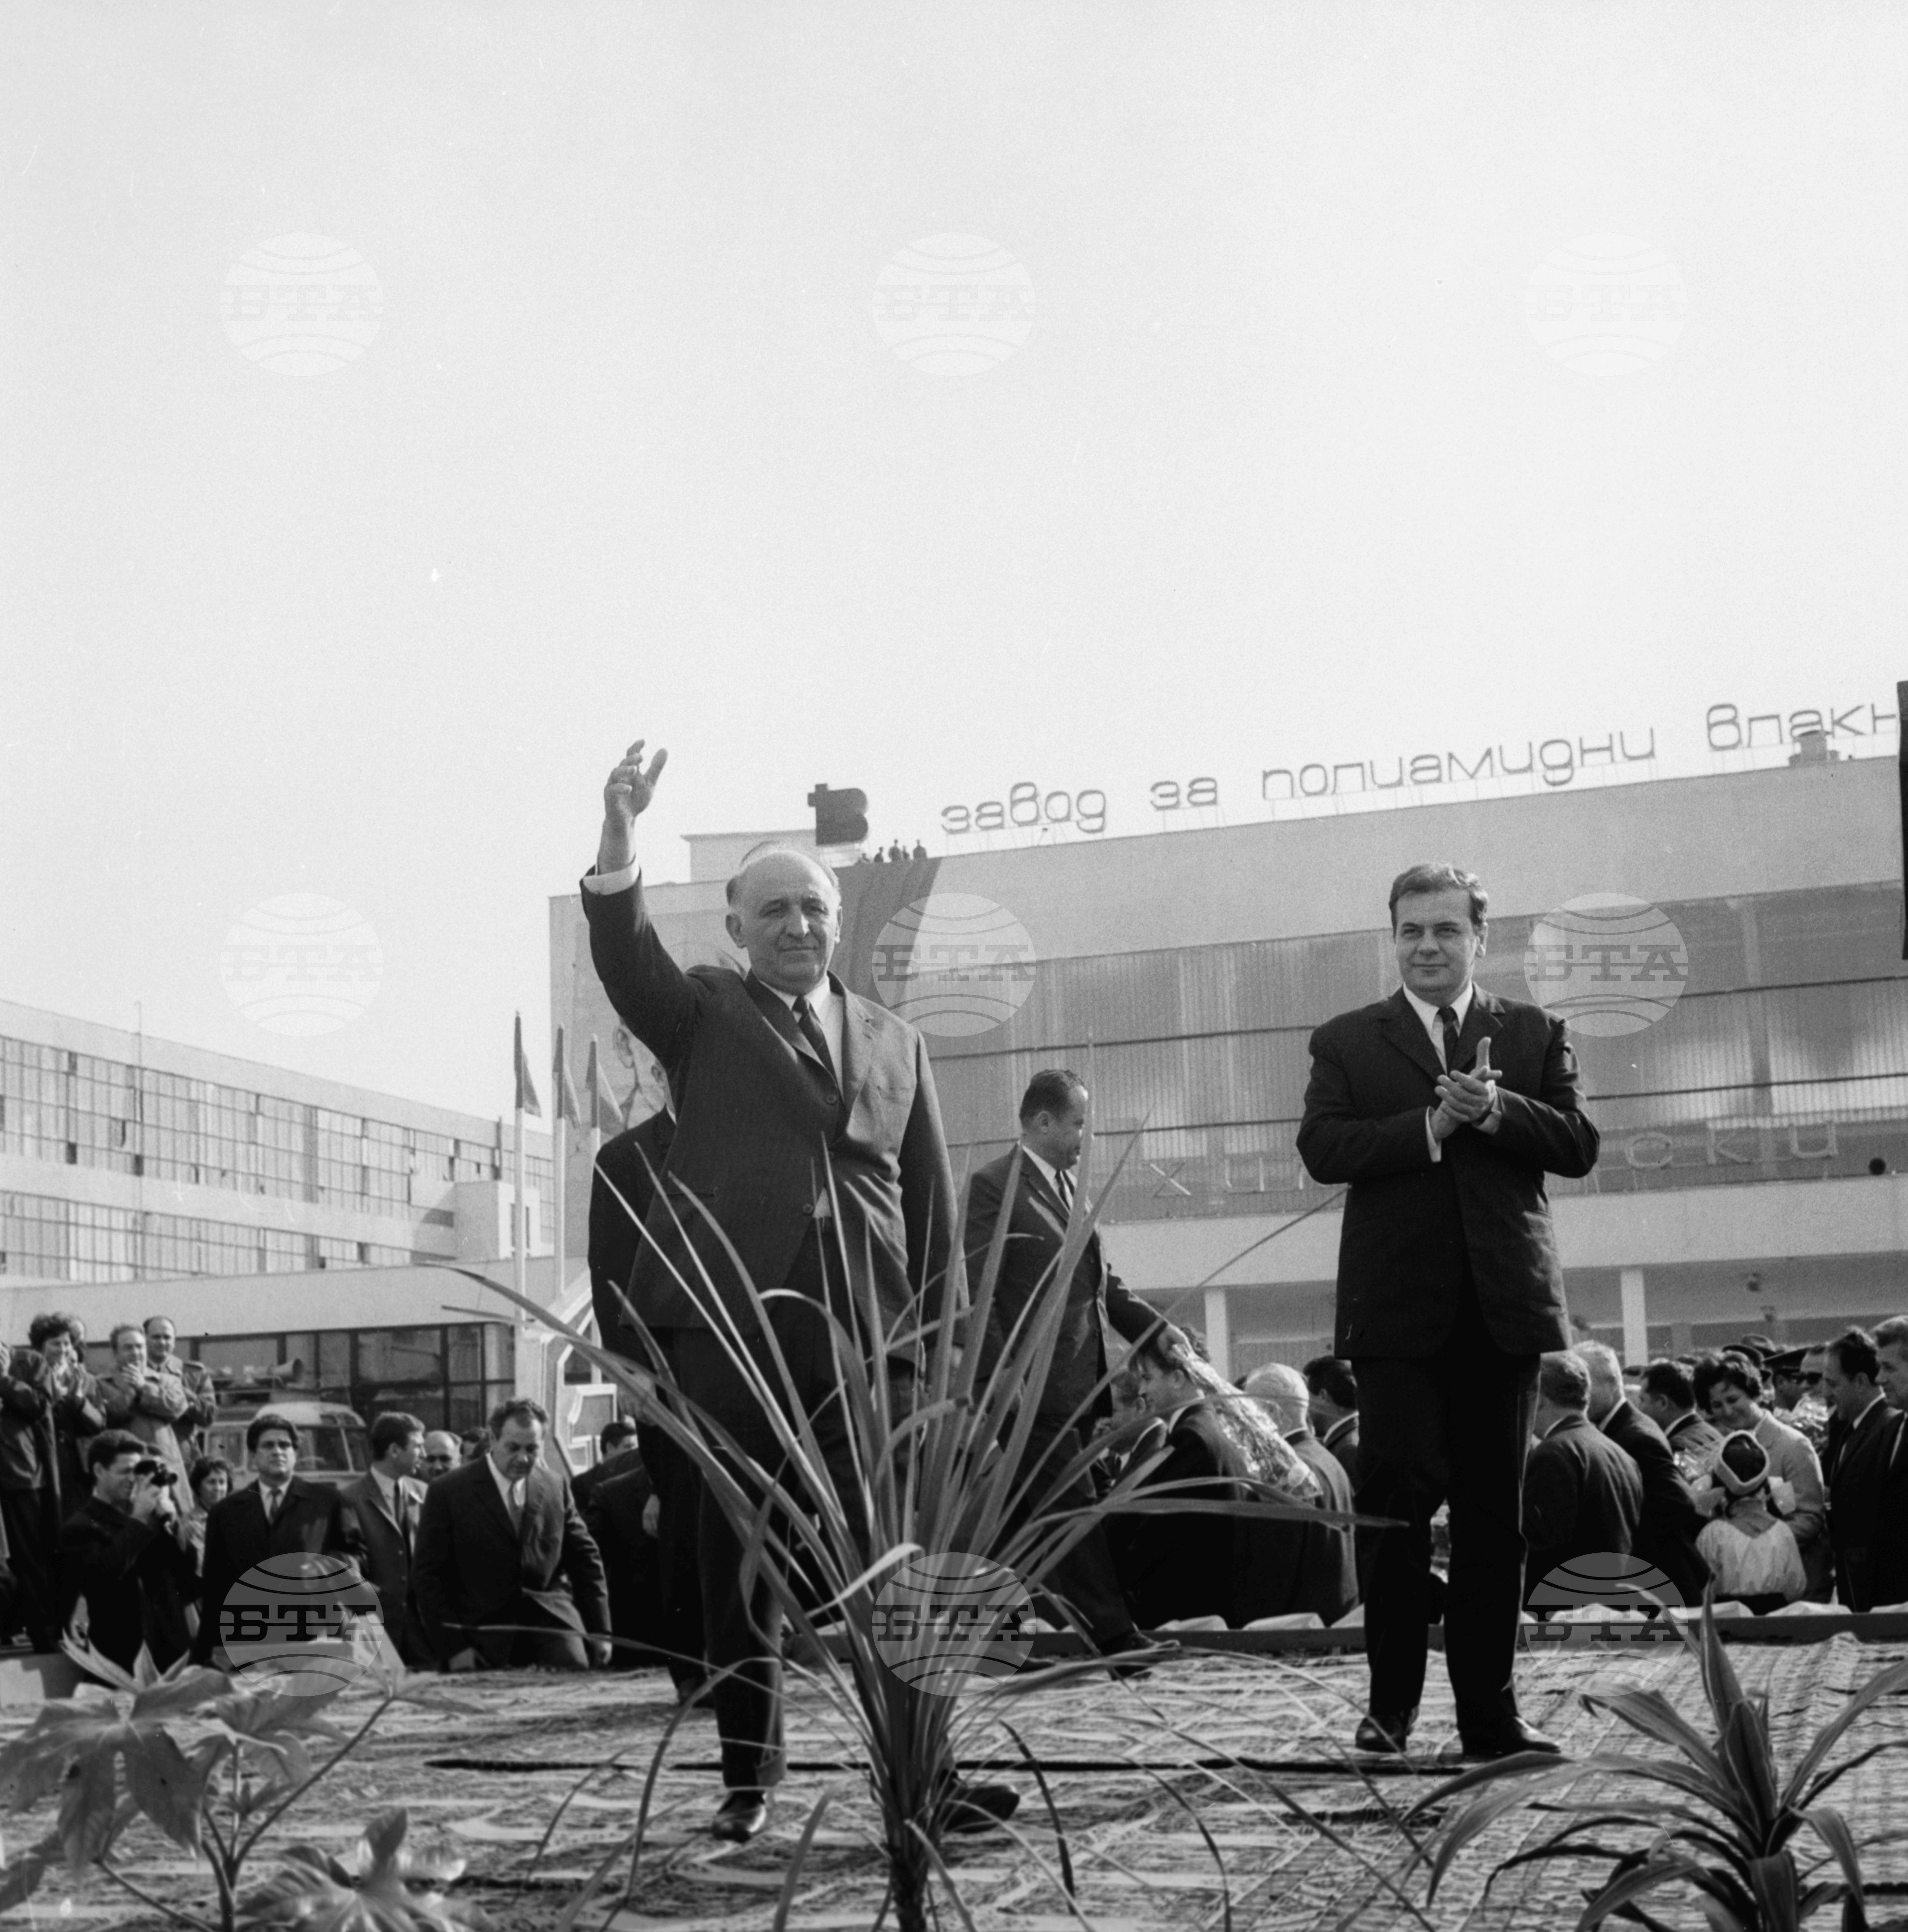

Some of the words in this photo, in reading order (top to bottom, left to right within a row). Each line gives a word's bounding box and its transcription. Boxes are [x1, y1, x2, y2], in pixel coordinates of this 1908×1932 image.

[941, 781, 1106, 835] завод
[1150, 776, 1218, 811] за
[1262, 727, 1655, 800] полиамидни
